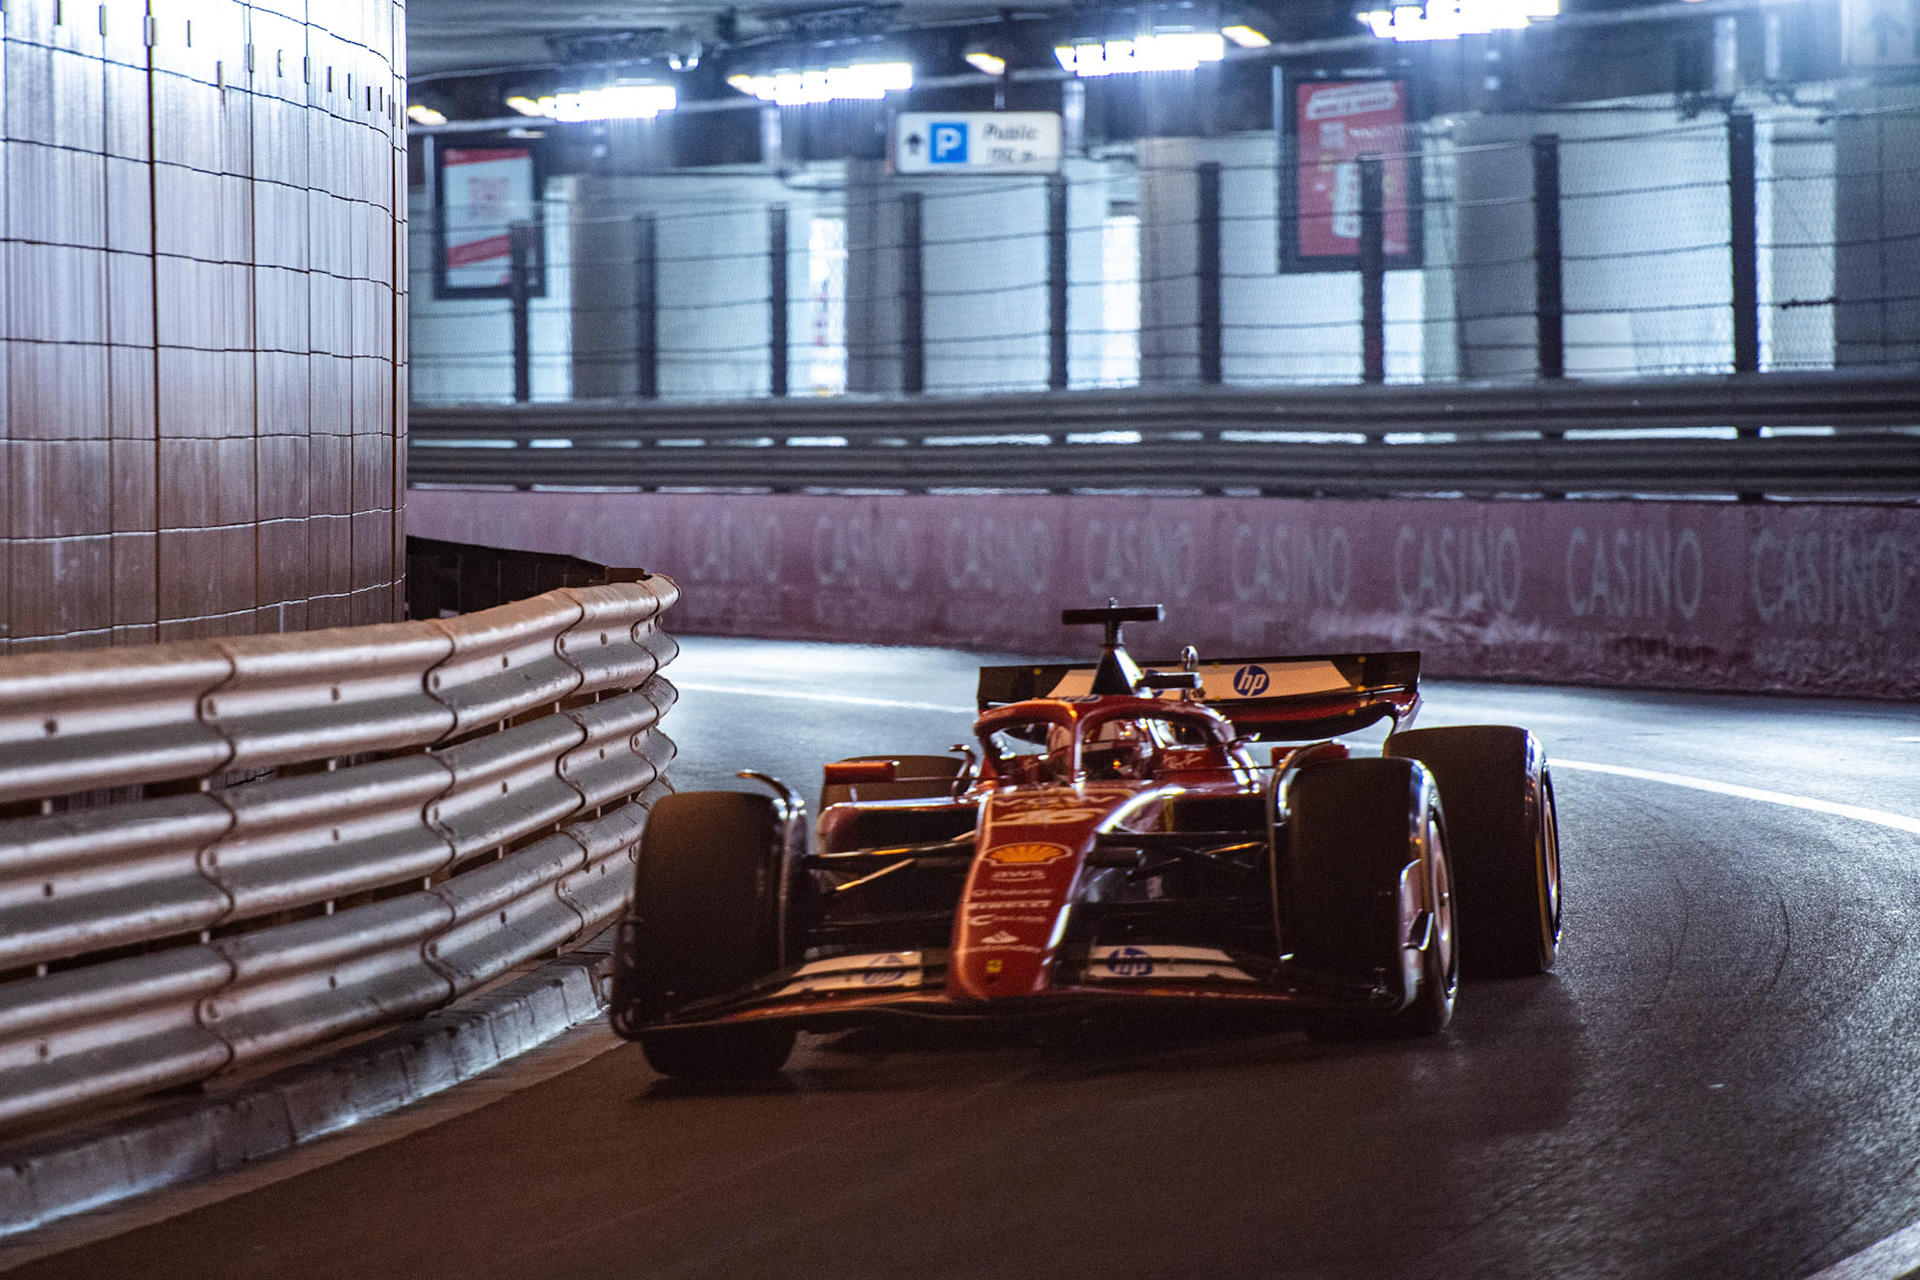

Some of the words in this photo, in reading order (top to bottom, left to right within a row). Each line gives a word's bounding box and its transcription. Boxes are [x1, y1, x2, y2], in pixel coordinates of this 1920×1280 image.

[935, 127, 963, 158] P
[1086, 518, 1197, 599] CASINO
[1231, 522, 1350, 604] CASINO
[1395, 524, 1519, 614] CASINO
[1566, 526, 1700, 619] CASINO
[1752, 527, 1900, 626] CASINO
[1236, 664, 1267, 697] hp
